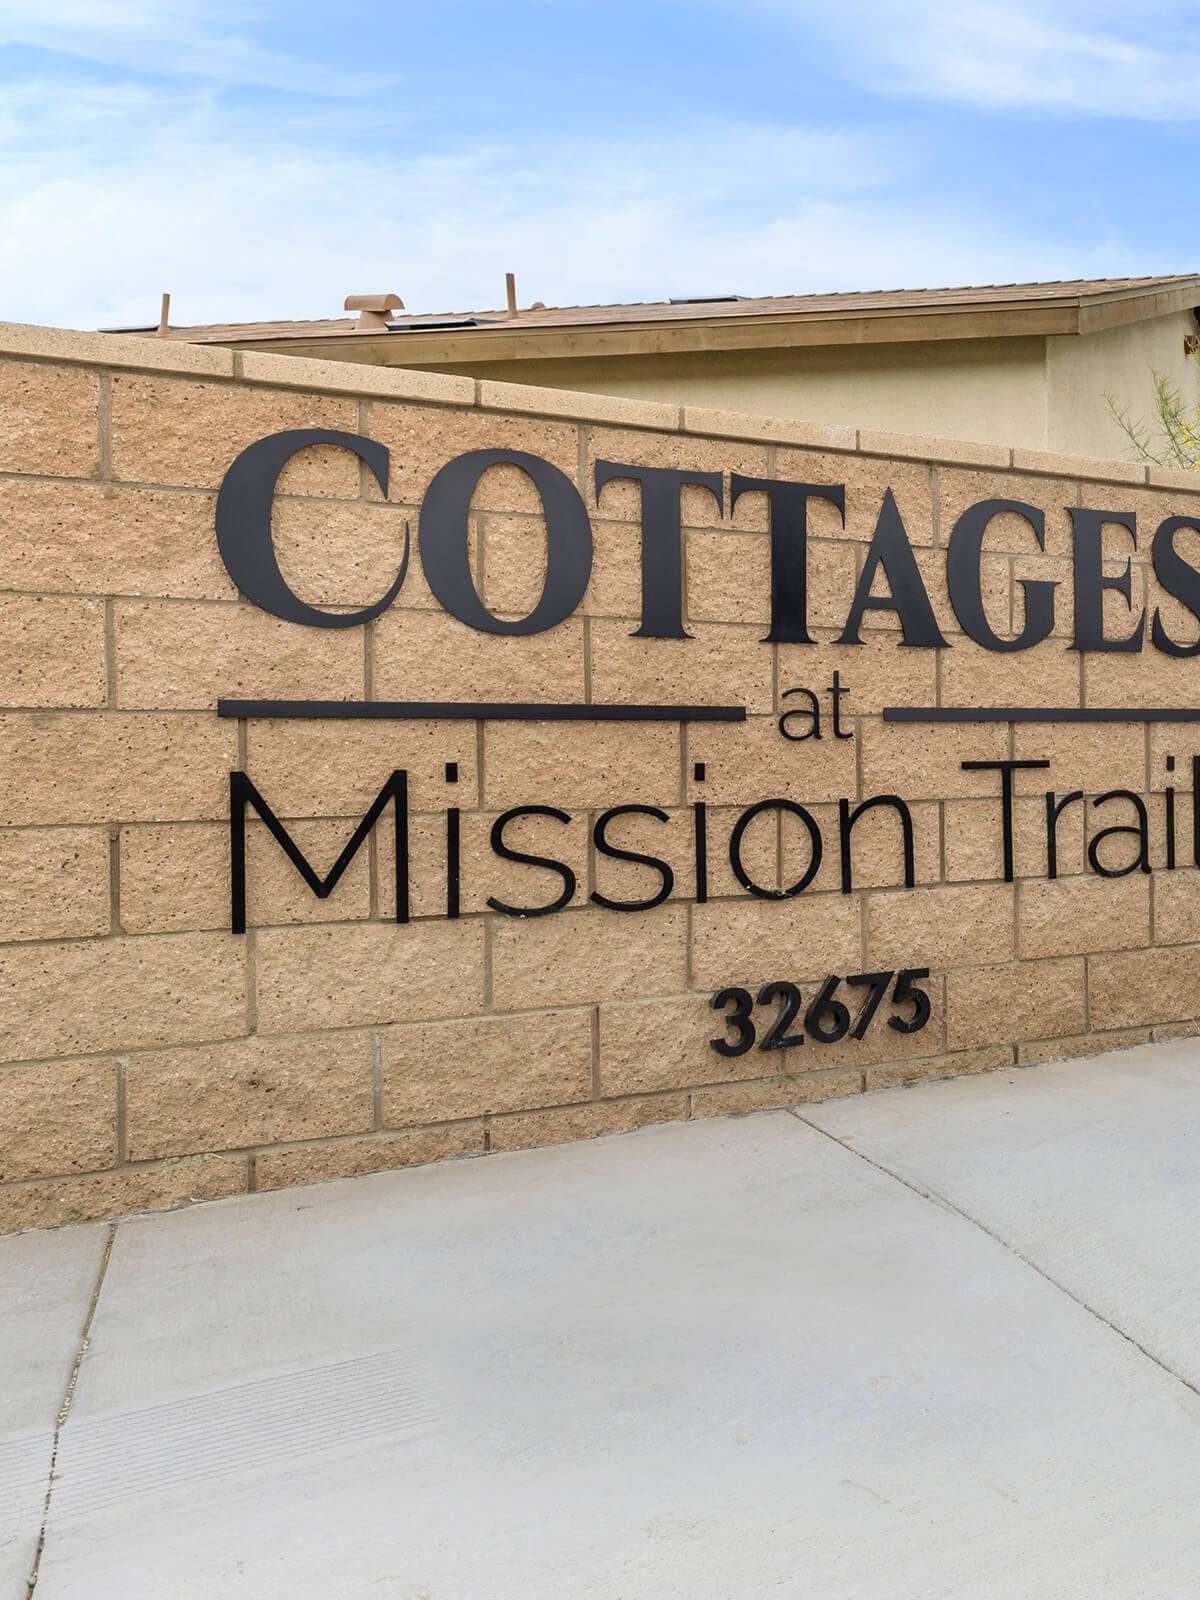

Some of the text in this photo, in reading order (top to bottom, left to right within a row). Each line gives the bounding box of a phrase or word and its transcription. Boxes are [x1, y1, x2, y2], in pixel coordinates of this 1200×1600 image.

[778, 669, 853, 742] at
[230, 762, 916, 935] Mission
[709, 967, 931, 1057] 32675
